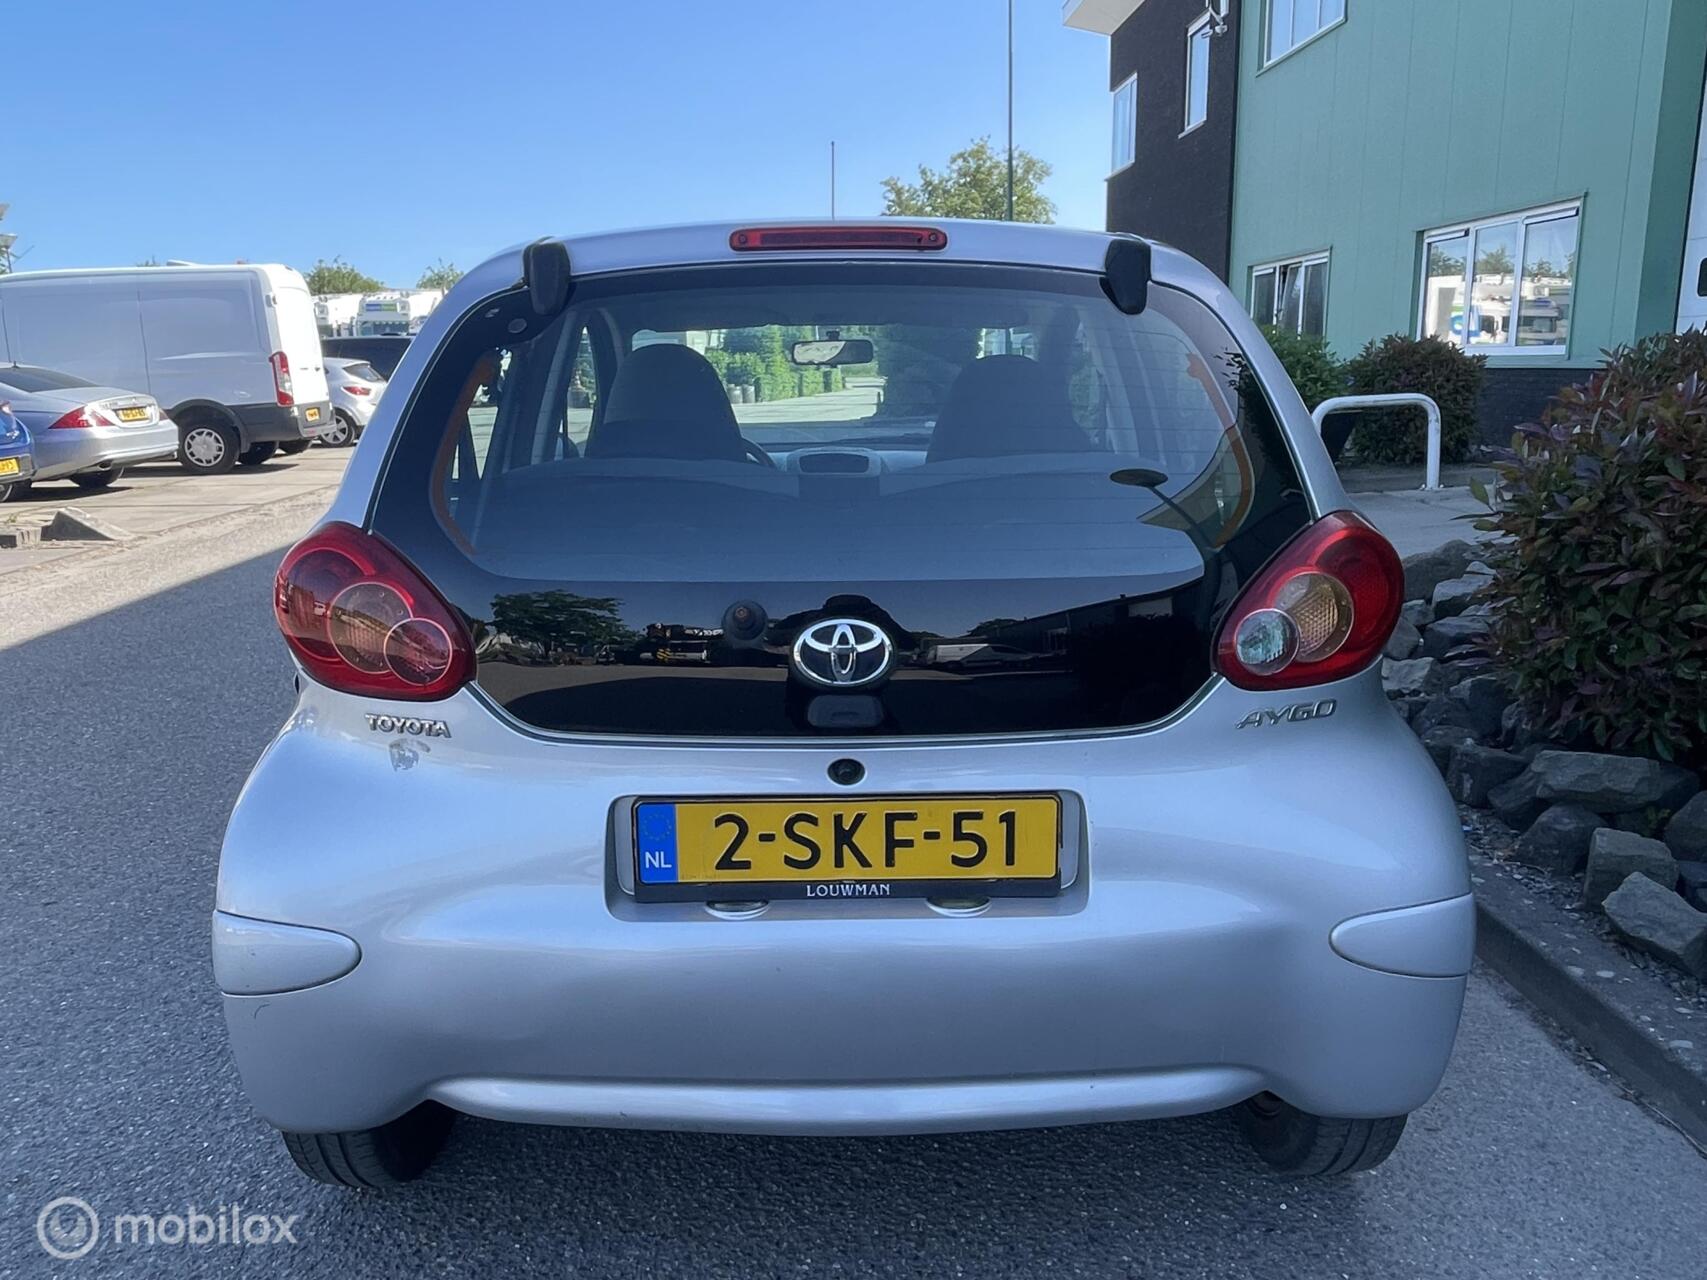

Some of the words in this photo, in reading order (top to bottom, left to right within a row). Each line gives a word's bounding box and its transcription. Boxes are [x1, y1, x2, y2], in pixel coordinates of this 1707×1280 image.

[365, 713, 452, 738] TOYOTA
[1235, 698, 1337, 729] AYGO
[713, 810, 1016, 871] 2-SKF-51
[645, 851, 672, 869] NL
[806, 883, 890, 897] LOUWMAN
